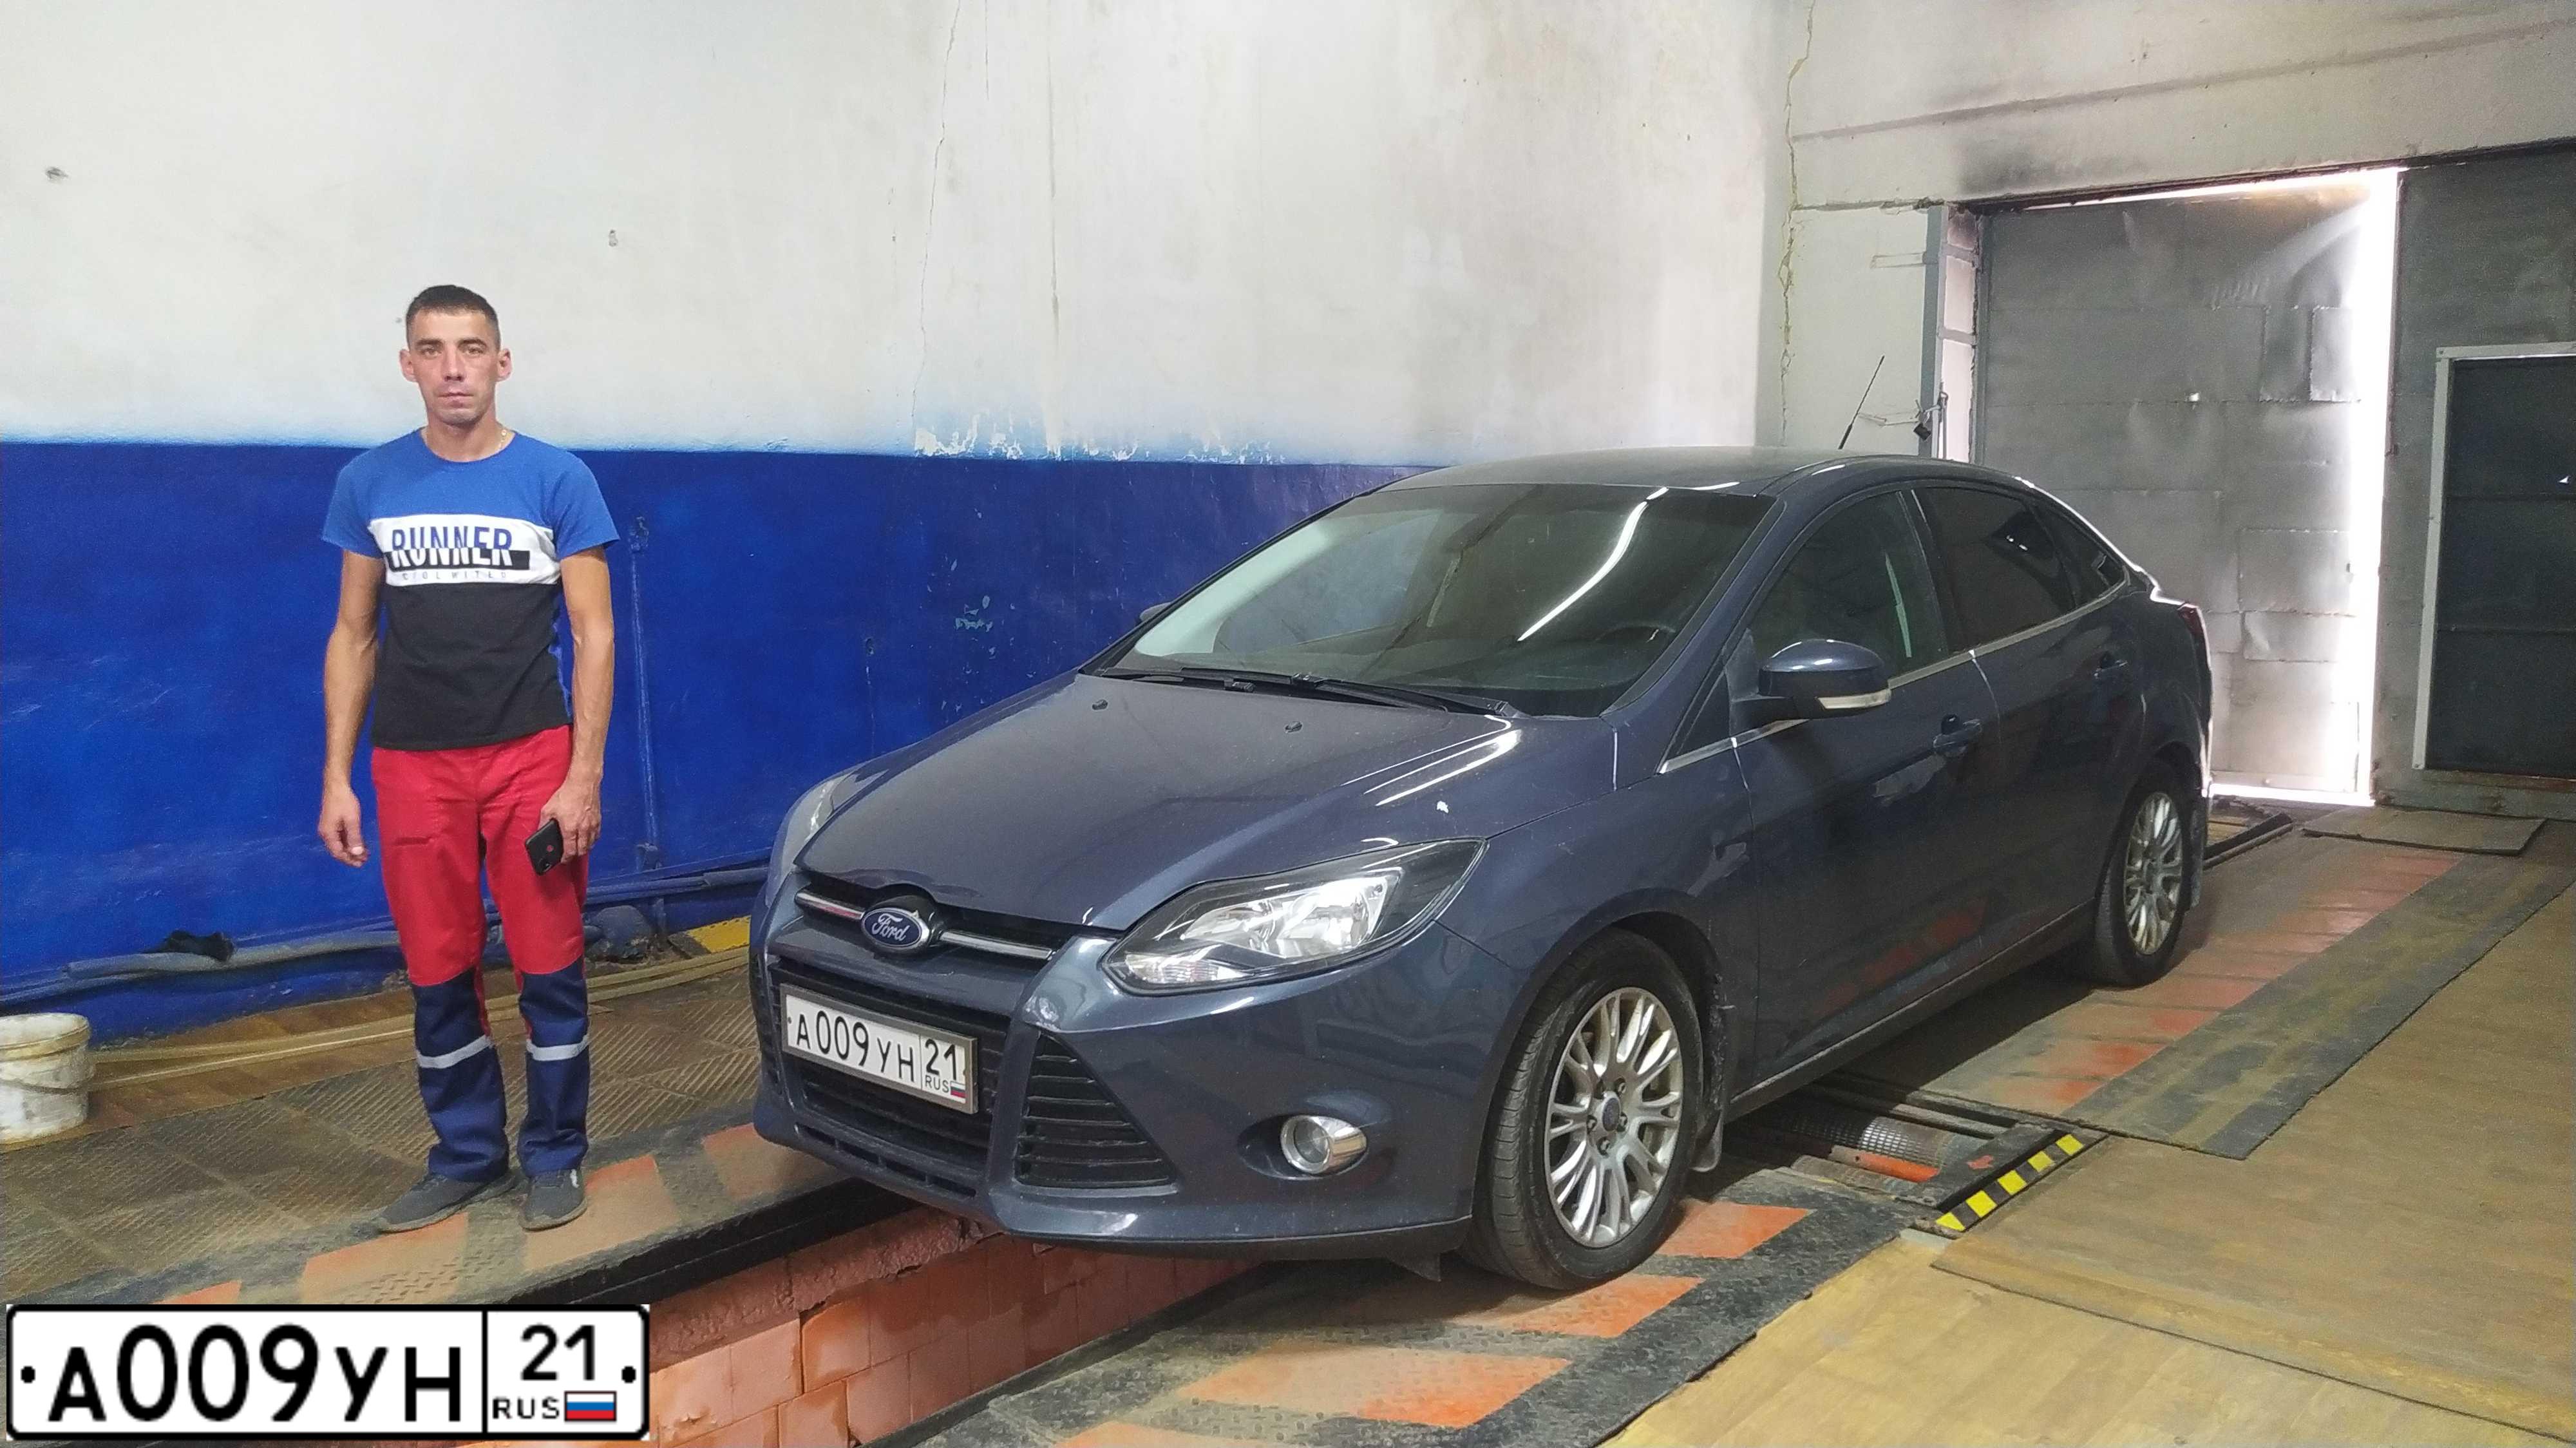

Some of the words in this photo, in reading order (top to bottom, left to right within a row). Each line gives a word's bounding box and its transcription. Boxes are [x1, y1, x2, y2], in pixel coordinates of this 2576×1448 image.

[392, 526, 513, 567] RUNNER
[871, 913, 909, 942] Ford
[925, 1038, 956, 1081] 21
[925, 1074, 949, 1093] RUS
